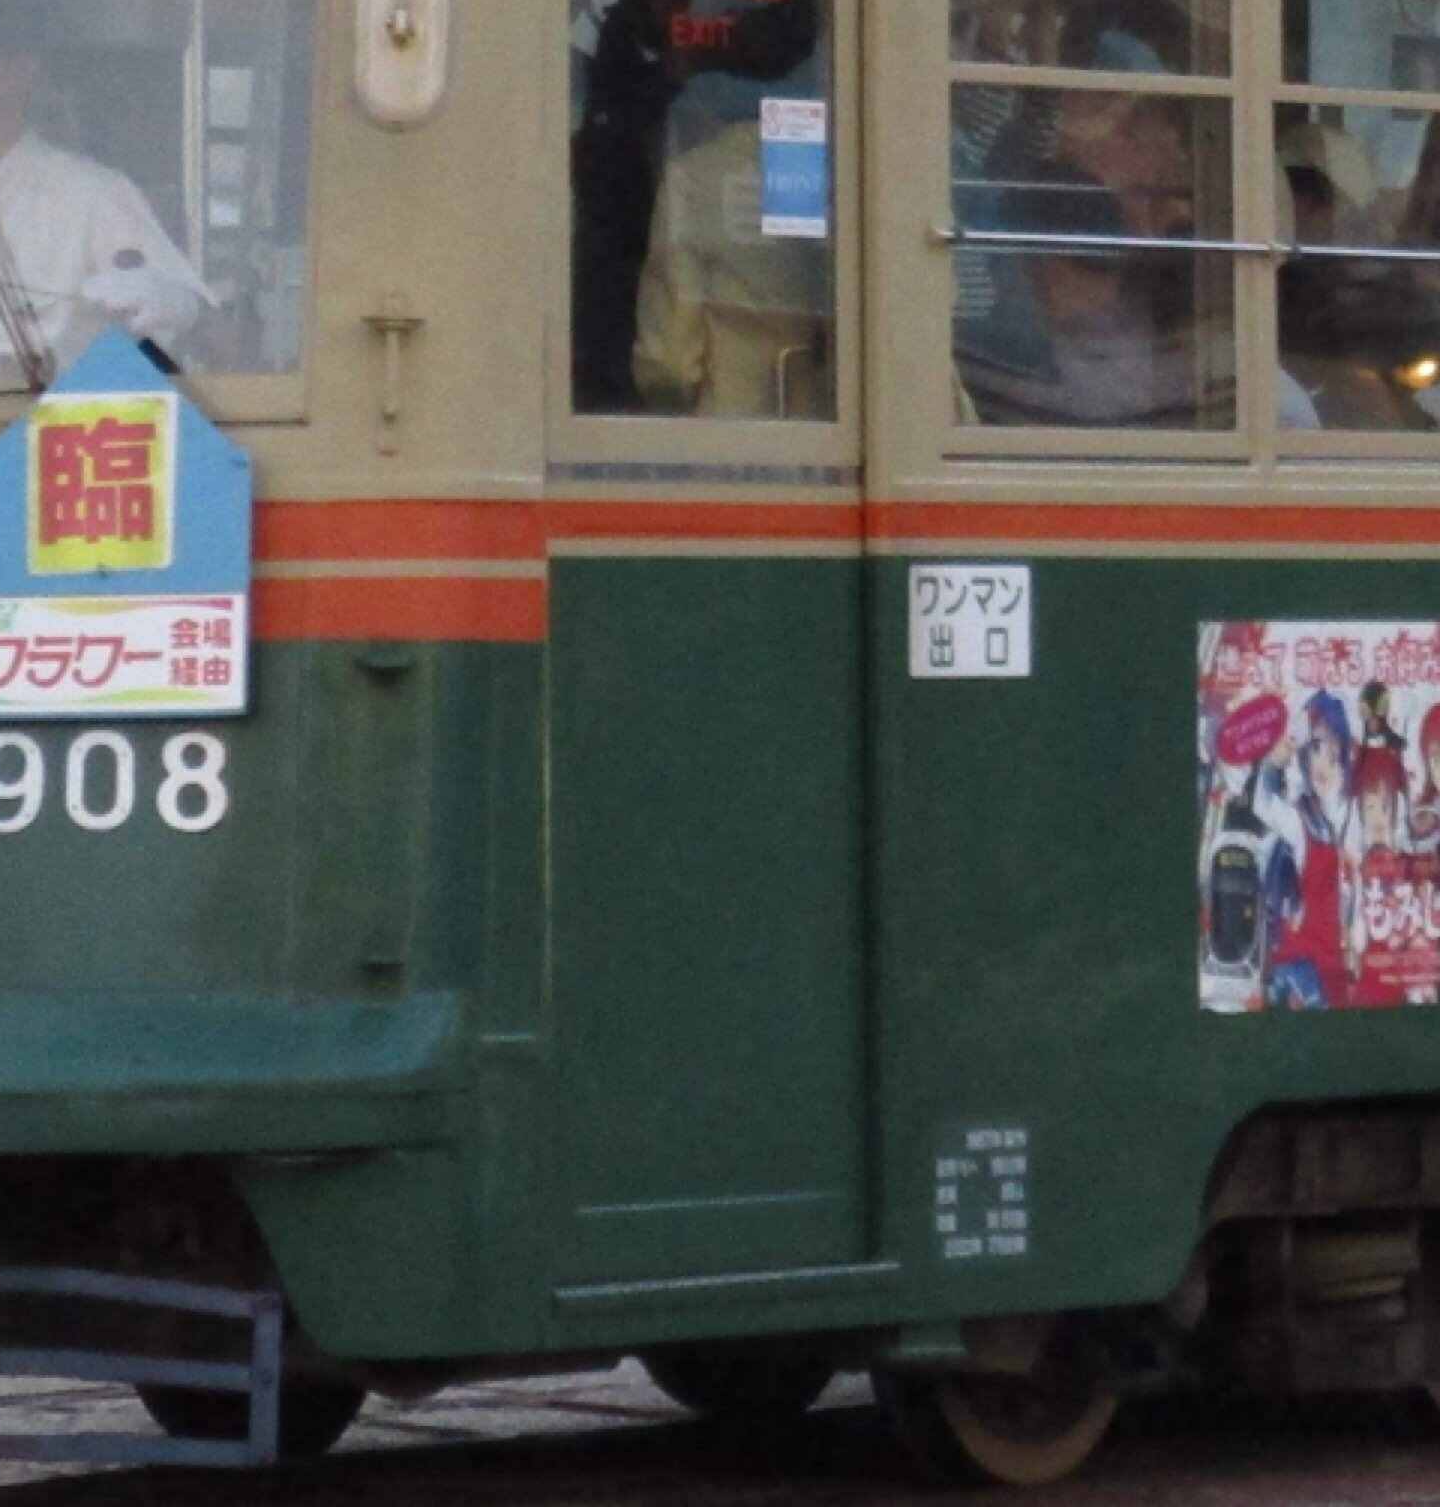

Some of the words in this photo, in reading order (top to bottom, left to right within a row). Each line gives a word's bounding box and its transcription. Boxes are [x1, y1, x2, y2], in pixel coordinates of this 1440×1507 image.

[671, 14, 735, 48] EXIT
[38, 417, 158, 545] 臨
[916, 575, 1024, 616] ワンマン
[169, 617, 233, 650] 会場
[928, 623, 1009, 667] 出口
[168, 655, 232, 686] 経由
